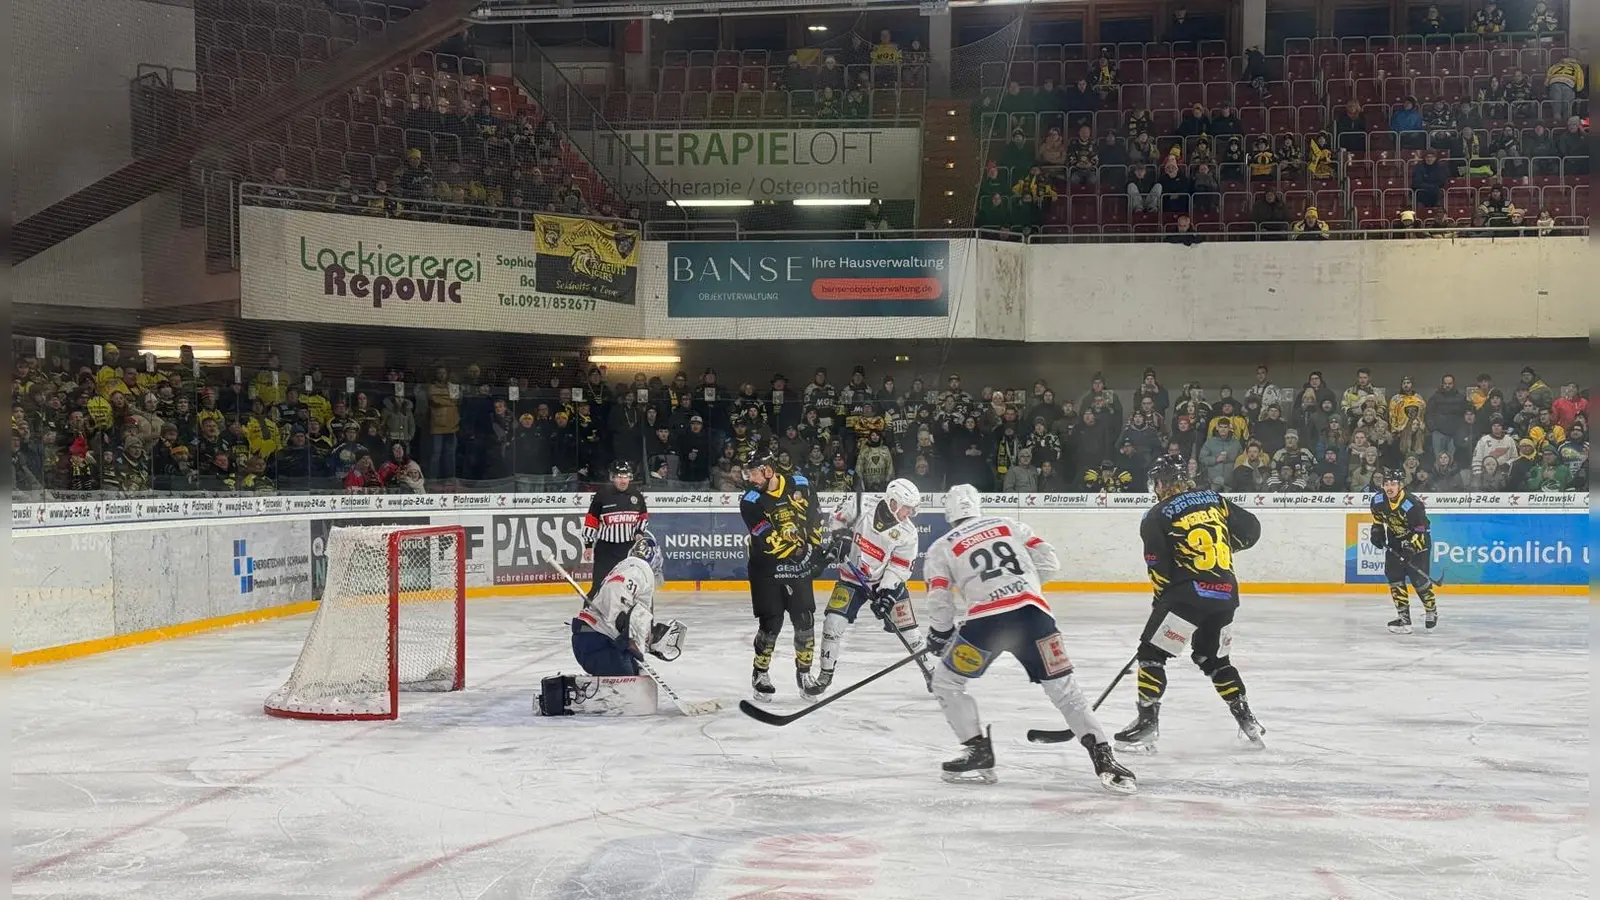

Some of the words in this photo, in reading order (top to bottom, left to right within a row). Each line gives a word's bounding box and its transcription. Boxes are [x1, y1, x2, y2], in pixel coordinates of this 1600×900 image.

[1553, 65, 1576, 76] 23
[600, 131, 882, 165] THERAPIELOFT
[760, 177, 879, 198] Osteopathie
[300, 236, 481, 282] Lackiererei
[673, 256, 804, 282] BANSE
[811, 256, 836, 268] Ihre
[839, 256, 944, 270] Hausverwaltung
[324, 263, 462, 308] Repovic
[698, 292, 778, 301] OBJEKTVERWALTUNG
[512, 495, 567, 505] www.pio-24.de
[655, 494, 713, 504] www.pio-24.de
[1043, 494, 1088, 503] Piotrowski
[1273, 494, 1335, 504] www.pio-24.de
[1436, 494, 1500, 504] www.pio-24.de
[1527, 494, 1576, 503] Piotrowski
[960, 527, 1002, 549] SCHILLER
[665, 550, 744, 560] VERSICHERUNG
[969, 541, 1025, 582] 28
[1433, 541, 1572, 563] Persönlich
[626, 579, 638, 595] 31
